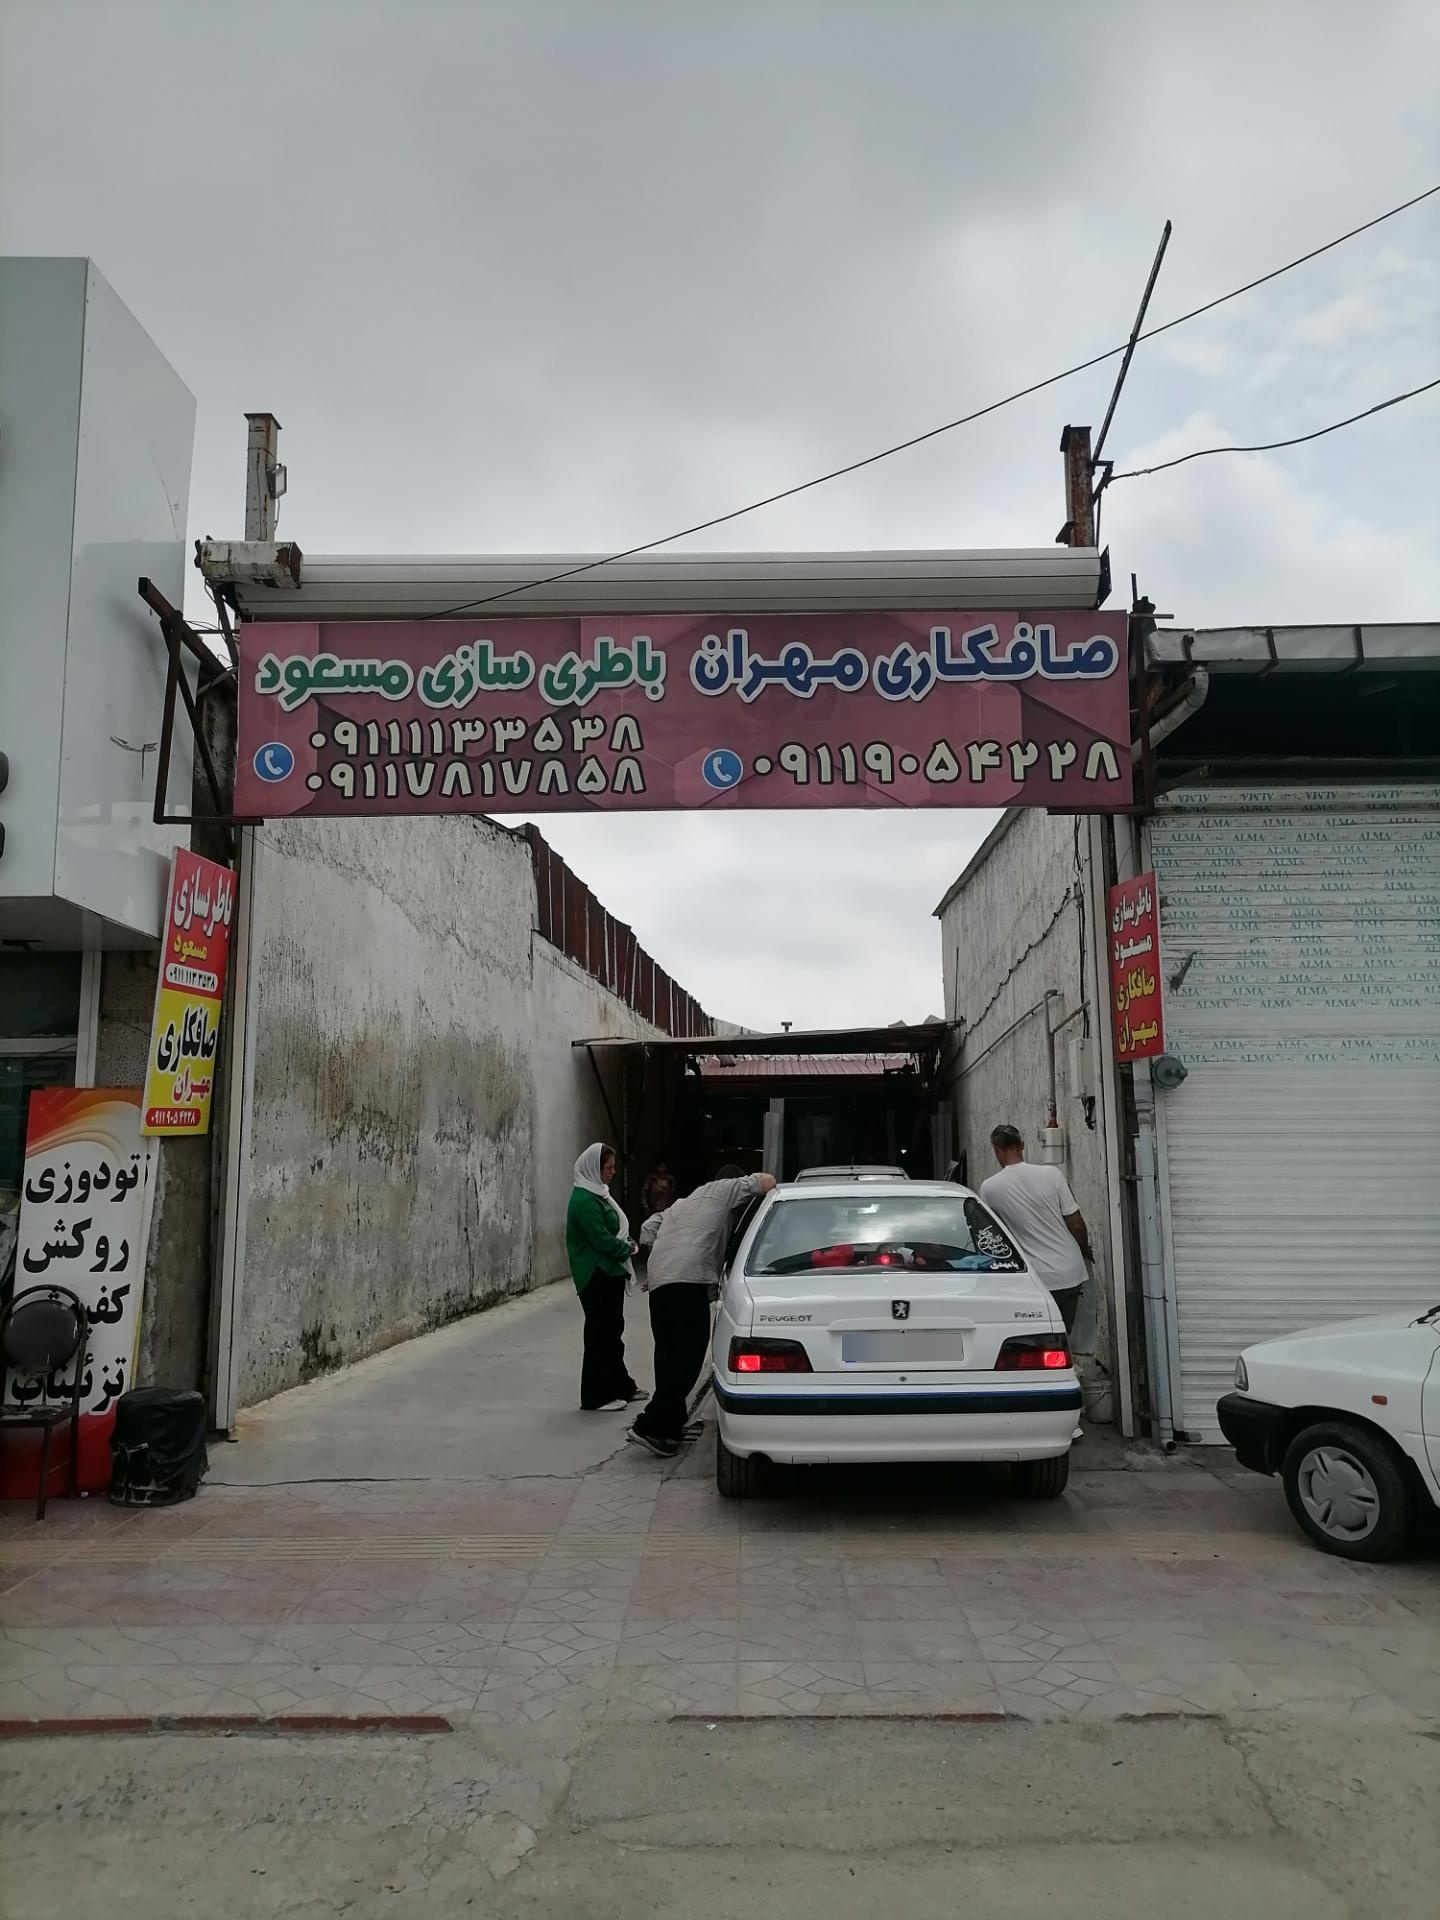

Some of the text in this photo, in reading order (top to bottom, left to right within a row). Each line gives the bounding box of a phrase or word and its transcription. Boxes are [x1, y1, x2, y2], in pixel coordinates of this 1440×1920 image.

[691, 623, 1118, 702] صافکاری مهران
[257, 638, 664, 710] باطری سازی مسعود
[311, 716, 643, 755] ۰۹۱۱۱۱۳۳۵۳۸
[754, 741, 1119, 783] ۰۹۱۱۹۰۵۴۲۲۸
[306, 758, 645, 796] ۰۹۱۱۷۸۱۷۸۵۸
[1198, 819, 1231, 828] ALMA
[1263, 819, 1294, 828] ALMA
[1325, 818, 1356, 826] ALMA
[1170, 832, 1202, 842] ALMA
[1232, 832, 1265, 842] ALMA
[1296, 832, 1328, 841] ALMA
[1359, 832, 1392, 841] ALMA
[1204, 848, 1236, 856] ALMA
[1267, 846, 1300, 854] ALMA
[1330, 845, 1362, 854] ALMA
[1394, 844, 1425, 853] ALMA
[1210, 858, 1242, 866] ALMA
[1273, 858, 1305, 866] ALMA
[1336, 856, 1368, 864] ALMA
[1400, 856, 1432, 864] ALMA
[1194, 871, 1226, 880] ALMA
[1257, 870, 1288, 878] ALMA
[1384, 868, 1416, 877] ALMA
[1194, 882, 1416, 894] ALMA ALMA ALMA ALMA
[1230, 910, 1260, 918] ALMA
[1290, 908, 1322, 916] ALMA
[1353, 907, 1384, 916] ALMA
[1228, 922, 1260, 930] ALMA
[1290, 921, 1322, 930] ALMA
[1353, 920, 1384, 928] ALMA
[1353, 934, 1386, 943] ALMA
[173, 933, 208, 962] مسعود
[1114, 933, 1153, 969] مسعود
[1298, 947, 1330, 956] ALMA
[1362, 946, 1393, 954] ALMA
[1236, 960, 1268, 969] ALMA
[1300, 960, 1332, 968] ALMA
[1364, 959, 1395, 968] ALMA
[1215, 972, 1440, 984] ALMA ALMA ALMA ALMA
[1116, 968, 1155, 1011] صافکاری
[1232, 987, 1264, 996] ALMA
[1296, 986, 1328, 996] ALMA
[1360, 986, 1392, 994] ALMA
[1196, 998, 1421, 1008] ALMA ALMA ALMA ALMA
[157, 1006, 216, 1072] صافکاری
[1119, 1014, 1158, 1053] مهران
[1212, 1040, 1244, 1050] ALMA
[1341, 1040, 1372, 1048] ALMA
[1405, 1040, 1437, 1048] ALMA
[1240, 1054, 1273, 1063] ALMA
[1304, 1053, 1336, 1062] ALMA
[1368, 1053, 1400, 1062] ALMA
[173, 1066, 211, 1102] مهران
[23, 1217, 130, 1273] روکش
[759, 1314, 814, 1322] PEUGEOT
